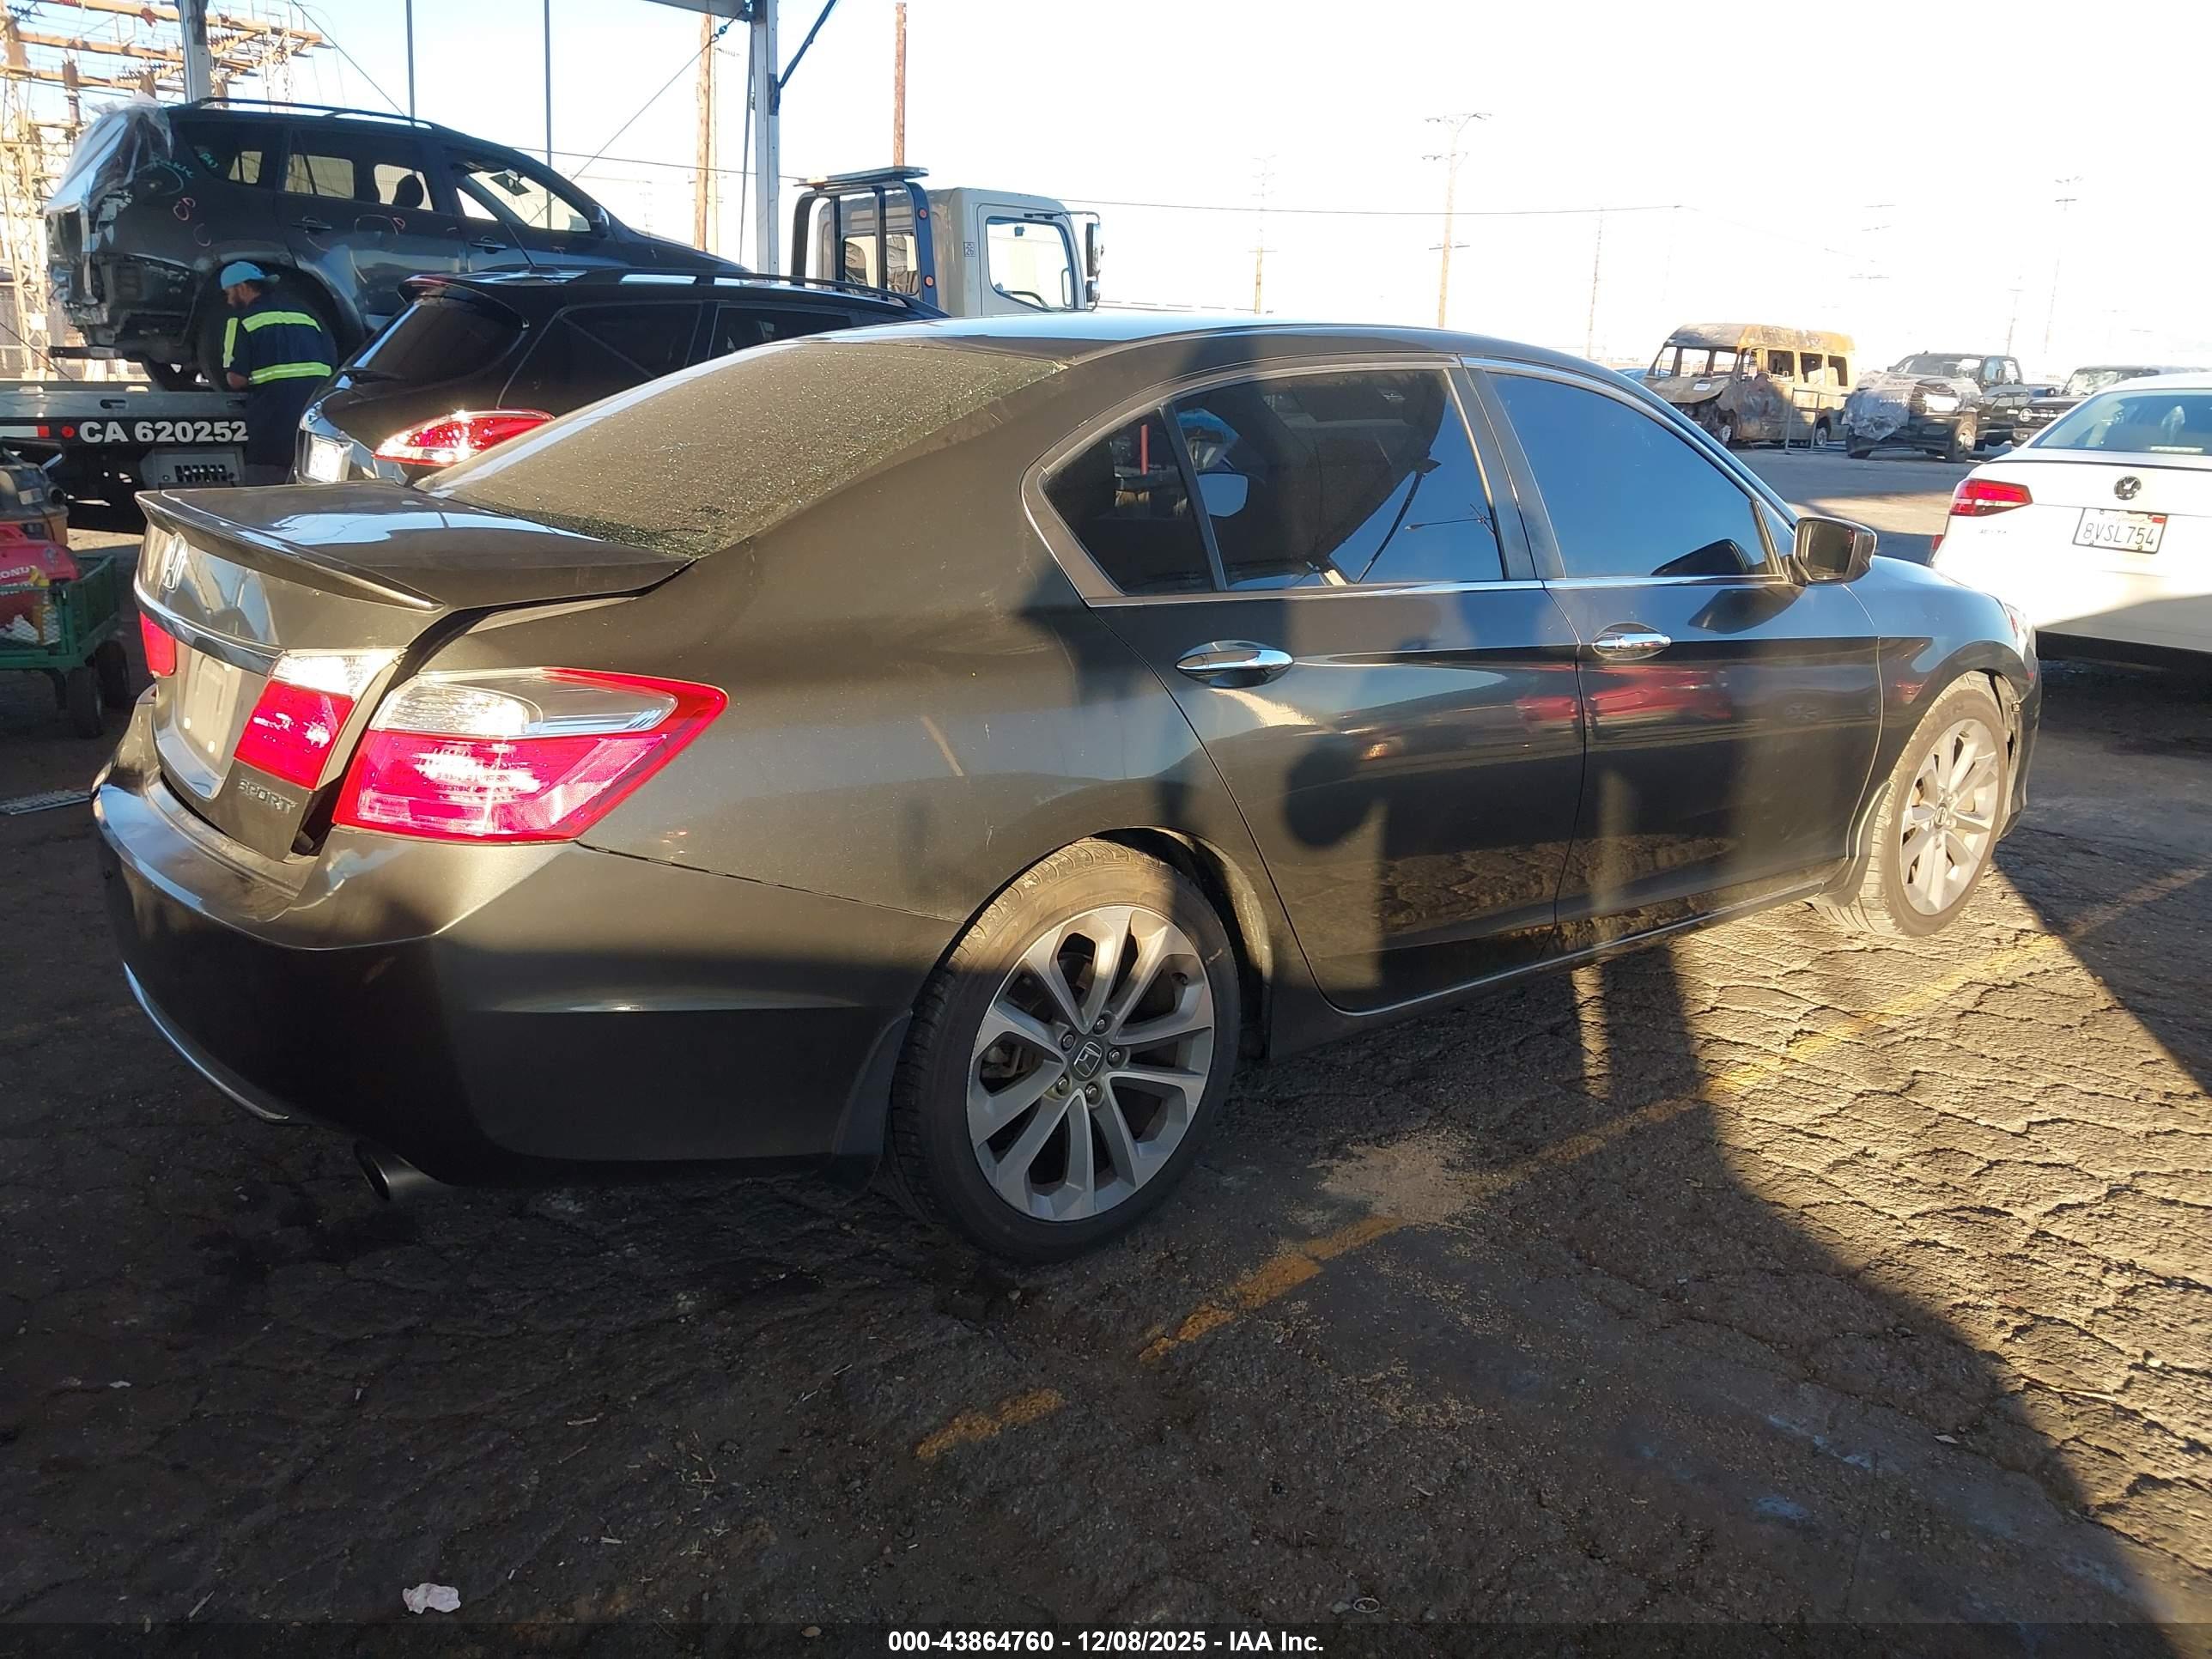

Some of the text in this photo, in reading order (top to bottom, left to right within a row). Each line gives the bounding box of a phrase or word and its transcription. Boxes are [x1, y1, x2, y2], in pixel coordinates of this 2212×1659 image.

[79, 421, 249, 443] CA 620252
[2083, 522, 2154, 546] 8VSL754
[238, 778, 297, 814] SPORT
